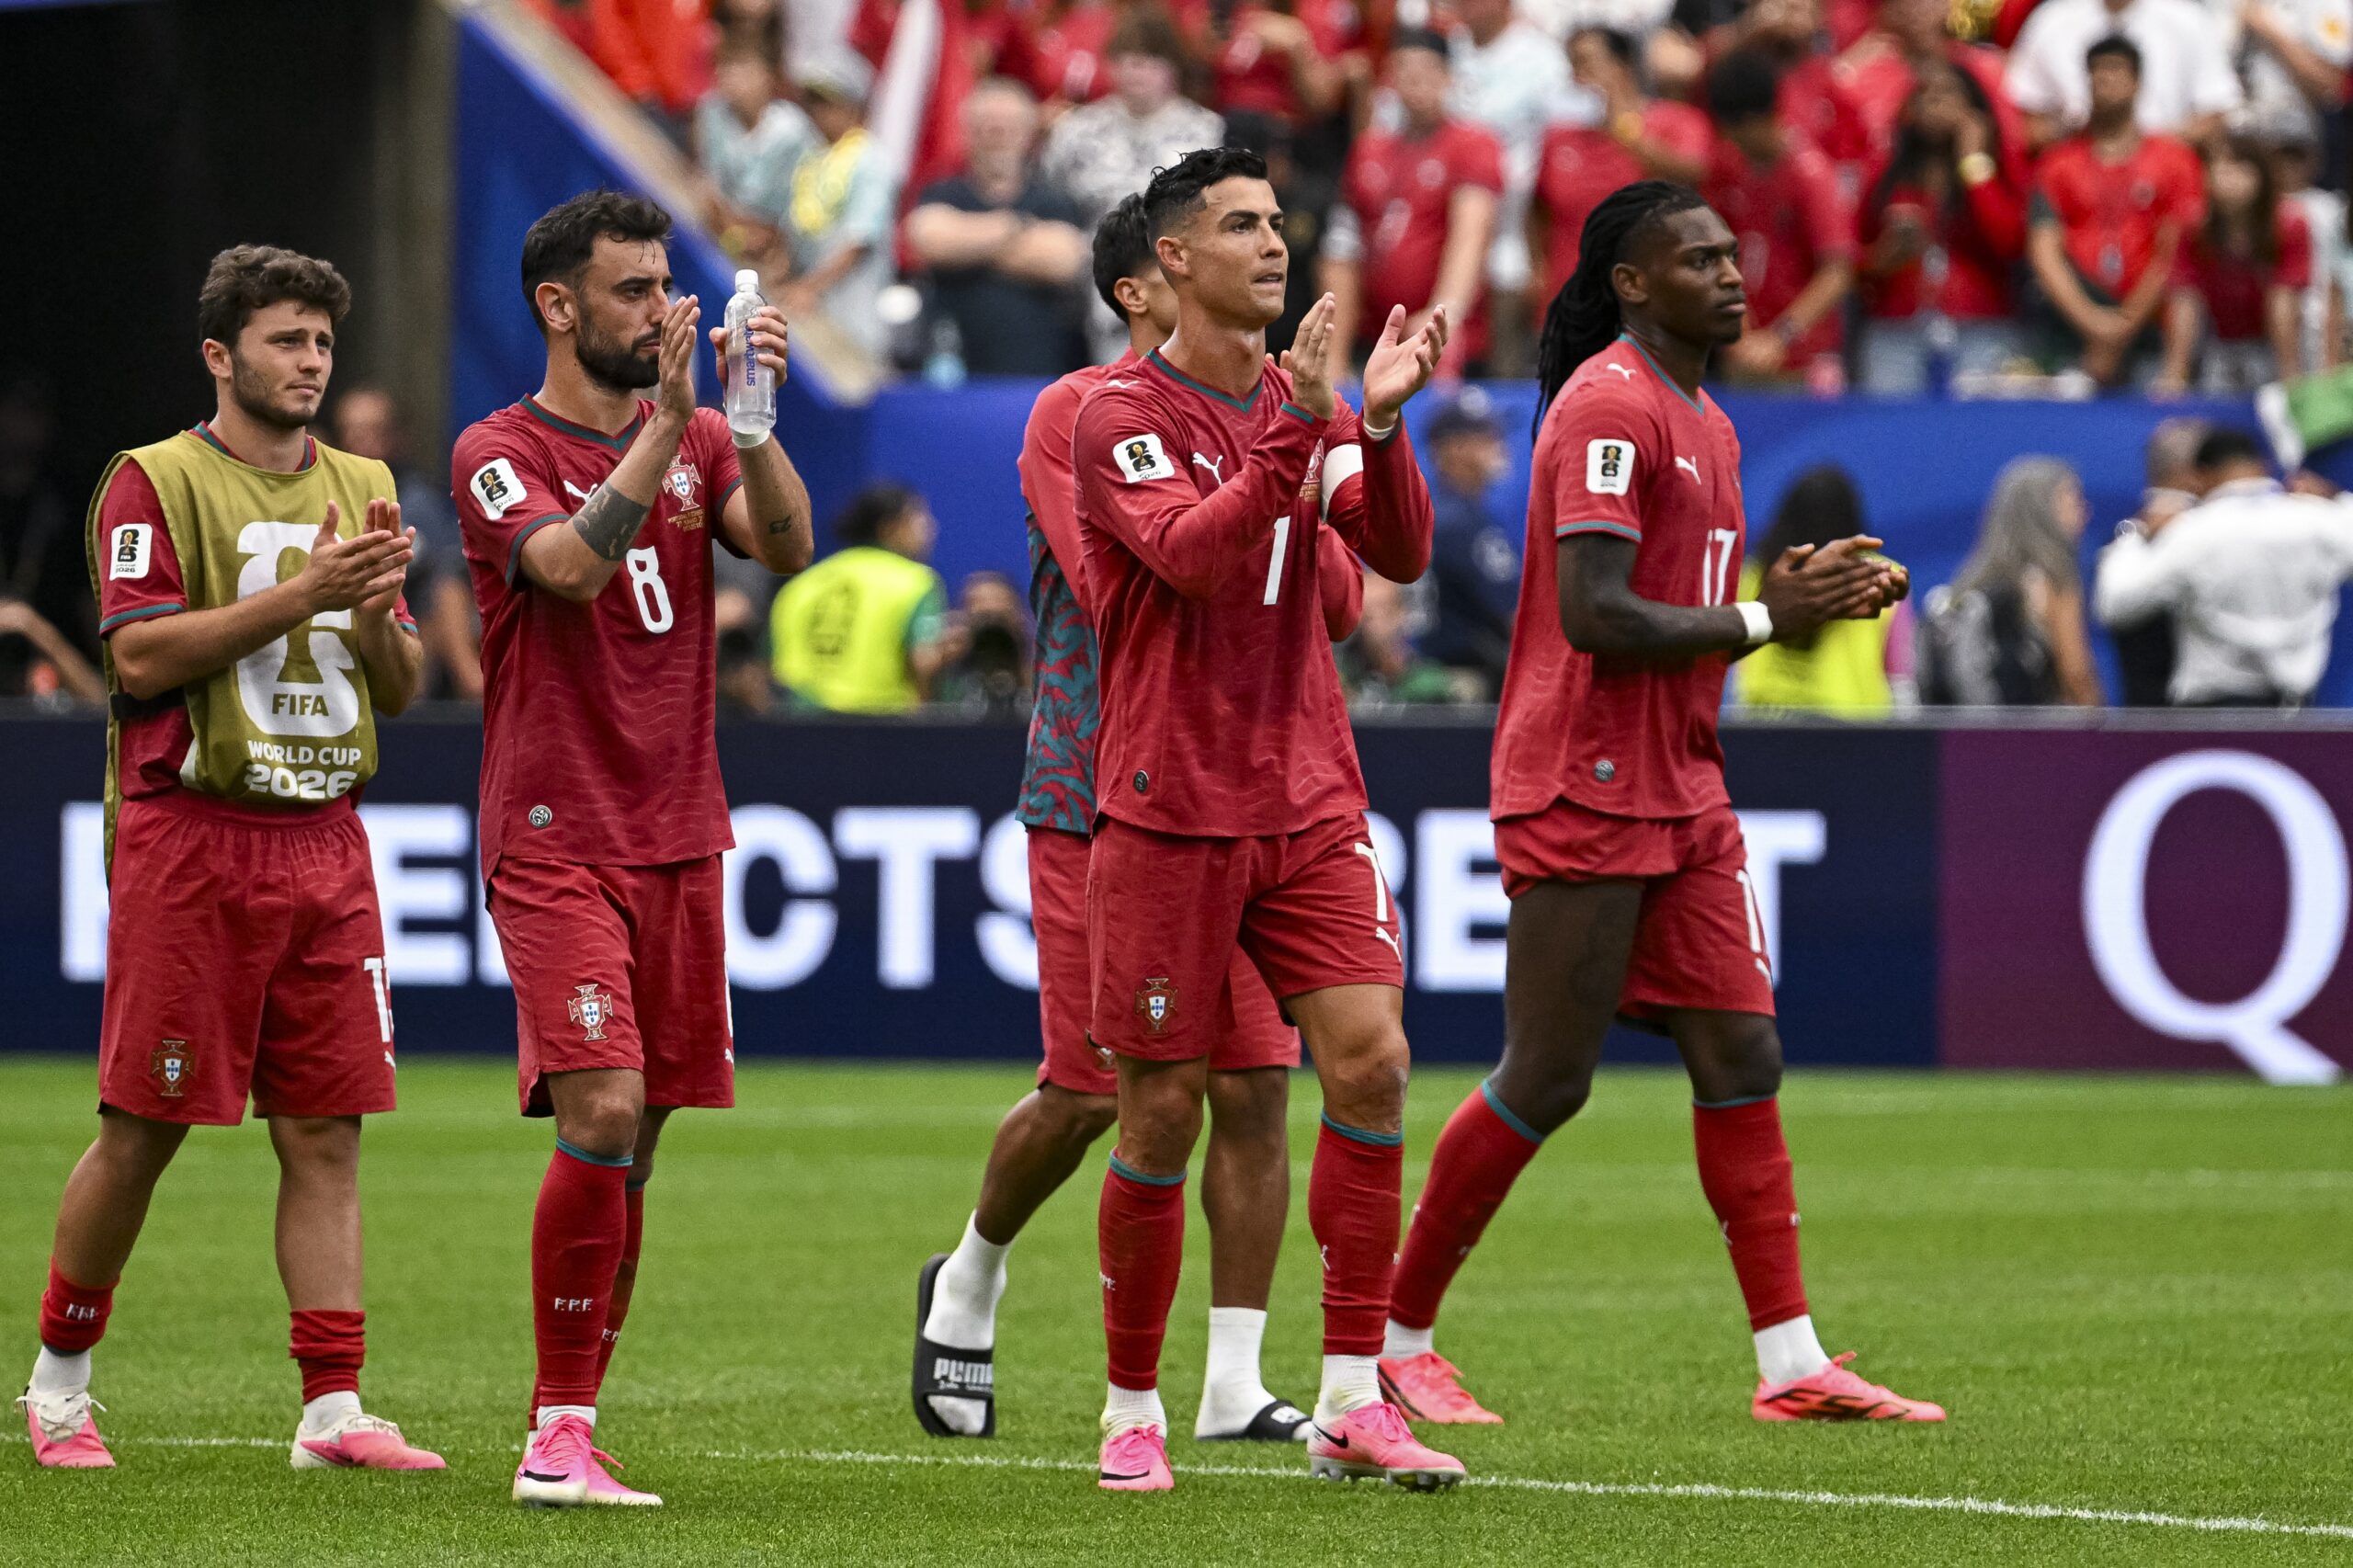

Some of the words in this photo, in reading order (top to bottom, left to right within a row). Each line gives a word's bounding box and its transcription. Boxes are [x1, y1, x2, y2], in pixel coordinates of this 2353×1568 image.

[626, 545, 674, 634] 8
[1702, 527, 1738, 607] 17
[272, 693, 329, 716] FIFA
[244, 764, 358, 799] 2026
[247, 740, 314, 764] WORLD
[318, 747, 361, 767] CUP
[2081, 748, 2352, 1085] Q
[363, 957, 394, 1042] 1
[554, 1297, 594, 1312] F.P.F.
